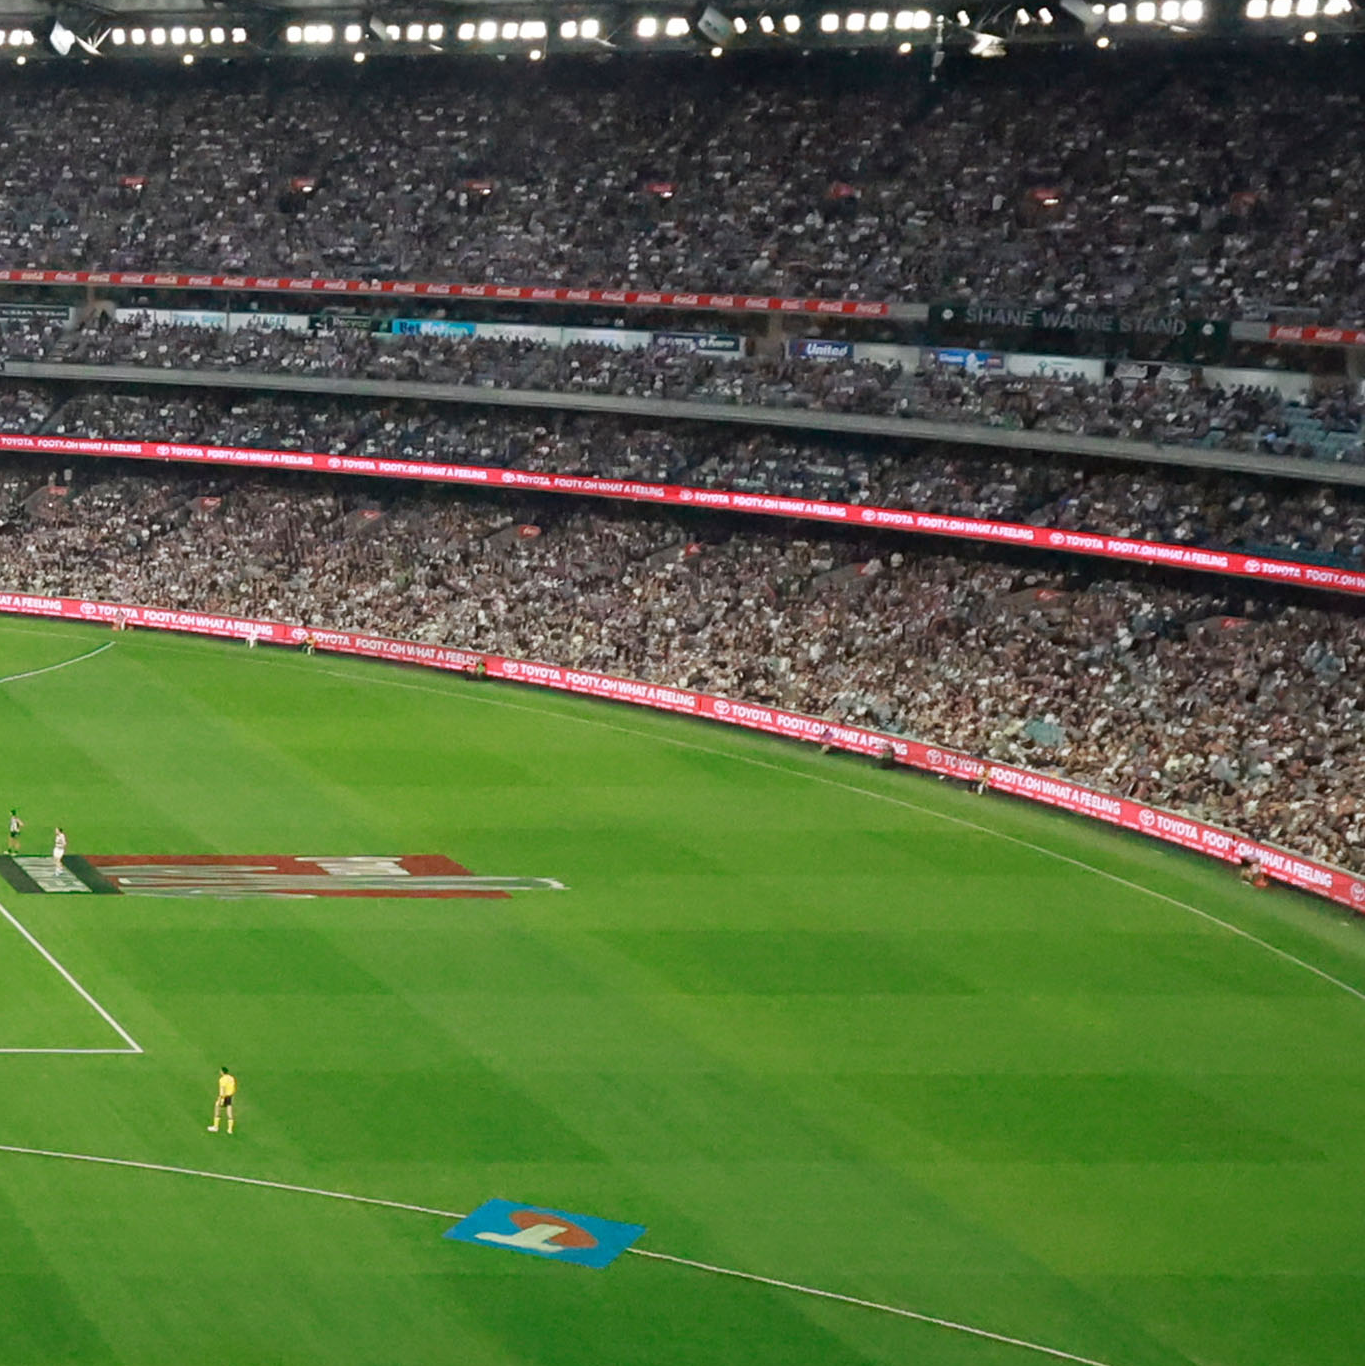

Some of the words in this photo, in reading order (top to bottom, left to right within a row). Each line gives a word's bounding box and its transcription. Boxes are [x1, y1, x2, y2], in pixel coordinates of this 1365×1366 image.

[965, 308, 1034, 327] SHANE
[1042, 310, 1114, 332] WARNE
[1120, 314, 1186, 336] STAND
[806, 344, 848, 356] United
[343, 459, 374, 470] TOYOTA
[422, 465, 445, 476] WHAT
[454, 468, 486, 479] FEELING
[1067, 535, 1102, 549] TOYOTA
[1157, 547, 1182, 560] WHAT
[1192, 552, 1227, 566] FEELING
[22, 597, 61, 610] FEELING
[521, 663, 559, 680] TOYOTA
[618, 681, 645, 697] WHAT
[656, 688, 694, 707] FEELING
[946, 754, 983, 776] TOYOTA
[1042, 780, 1070, 800] WHAT
[1080, 791, 1120, 815] FEELING
